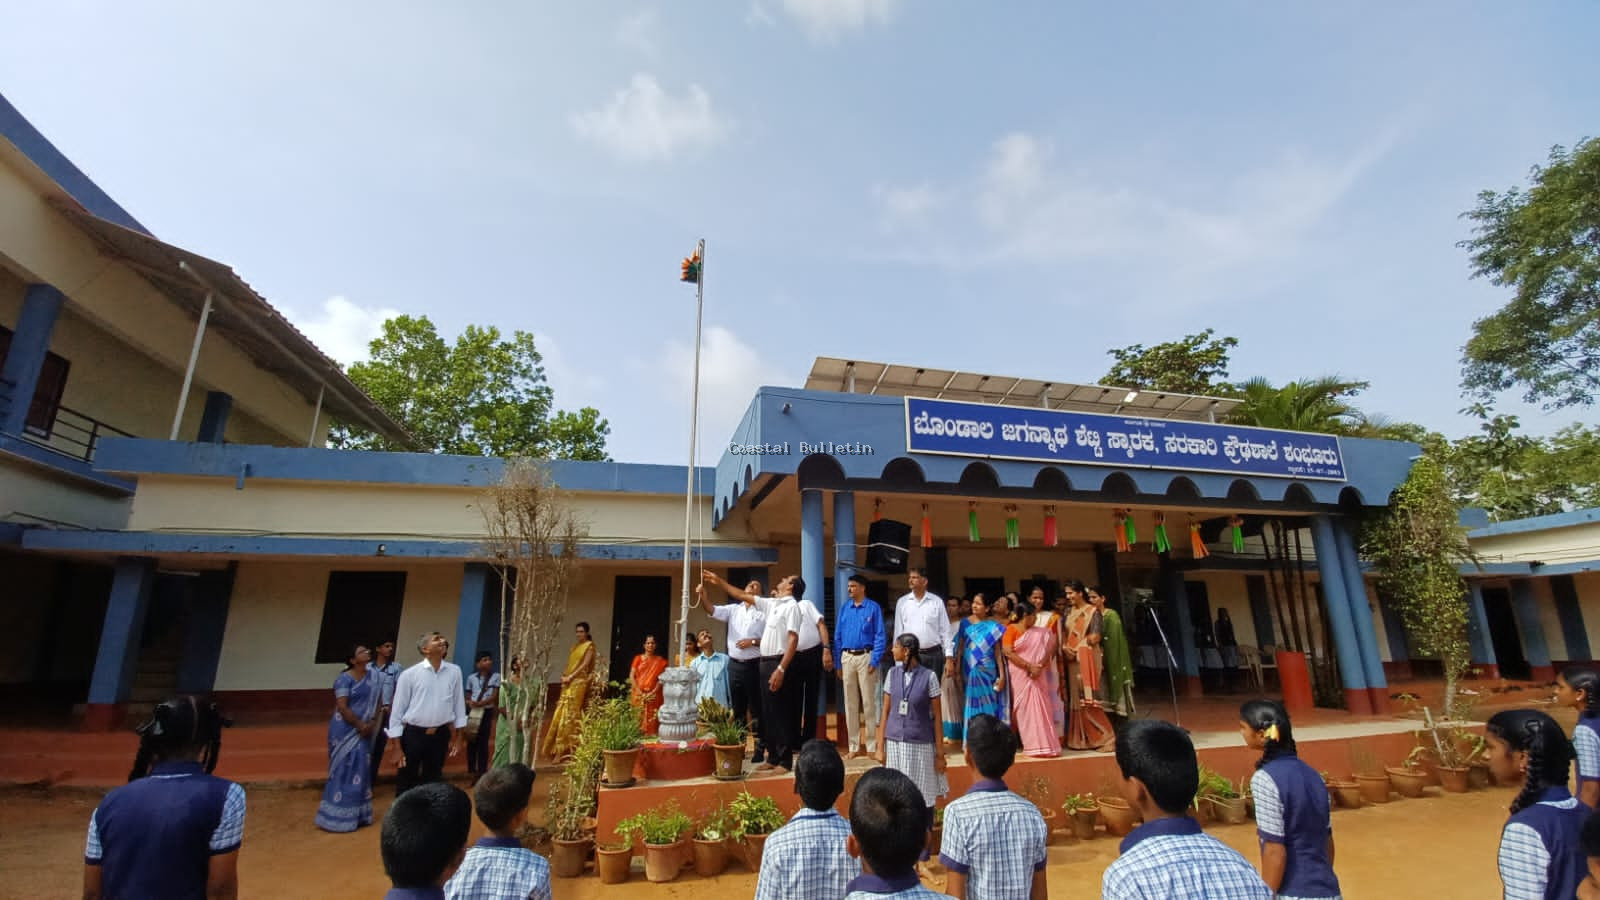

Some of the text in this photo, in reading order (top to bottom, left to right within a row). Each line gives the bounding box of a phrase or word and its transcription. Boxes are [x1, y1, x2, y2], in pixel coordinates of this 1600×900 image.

[914, 411, 1338, 467] ಬೊಂಡಾಲ ಜಗನ್ನಾಥ ಶೆಟ್ಟಿ ಸ್ಮಾರಕ, ಸರಕಾರಿ ಪ್ರೌಢಶಾಲೆ ಶಂಭೂರು
